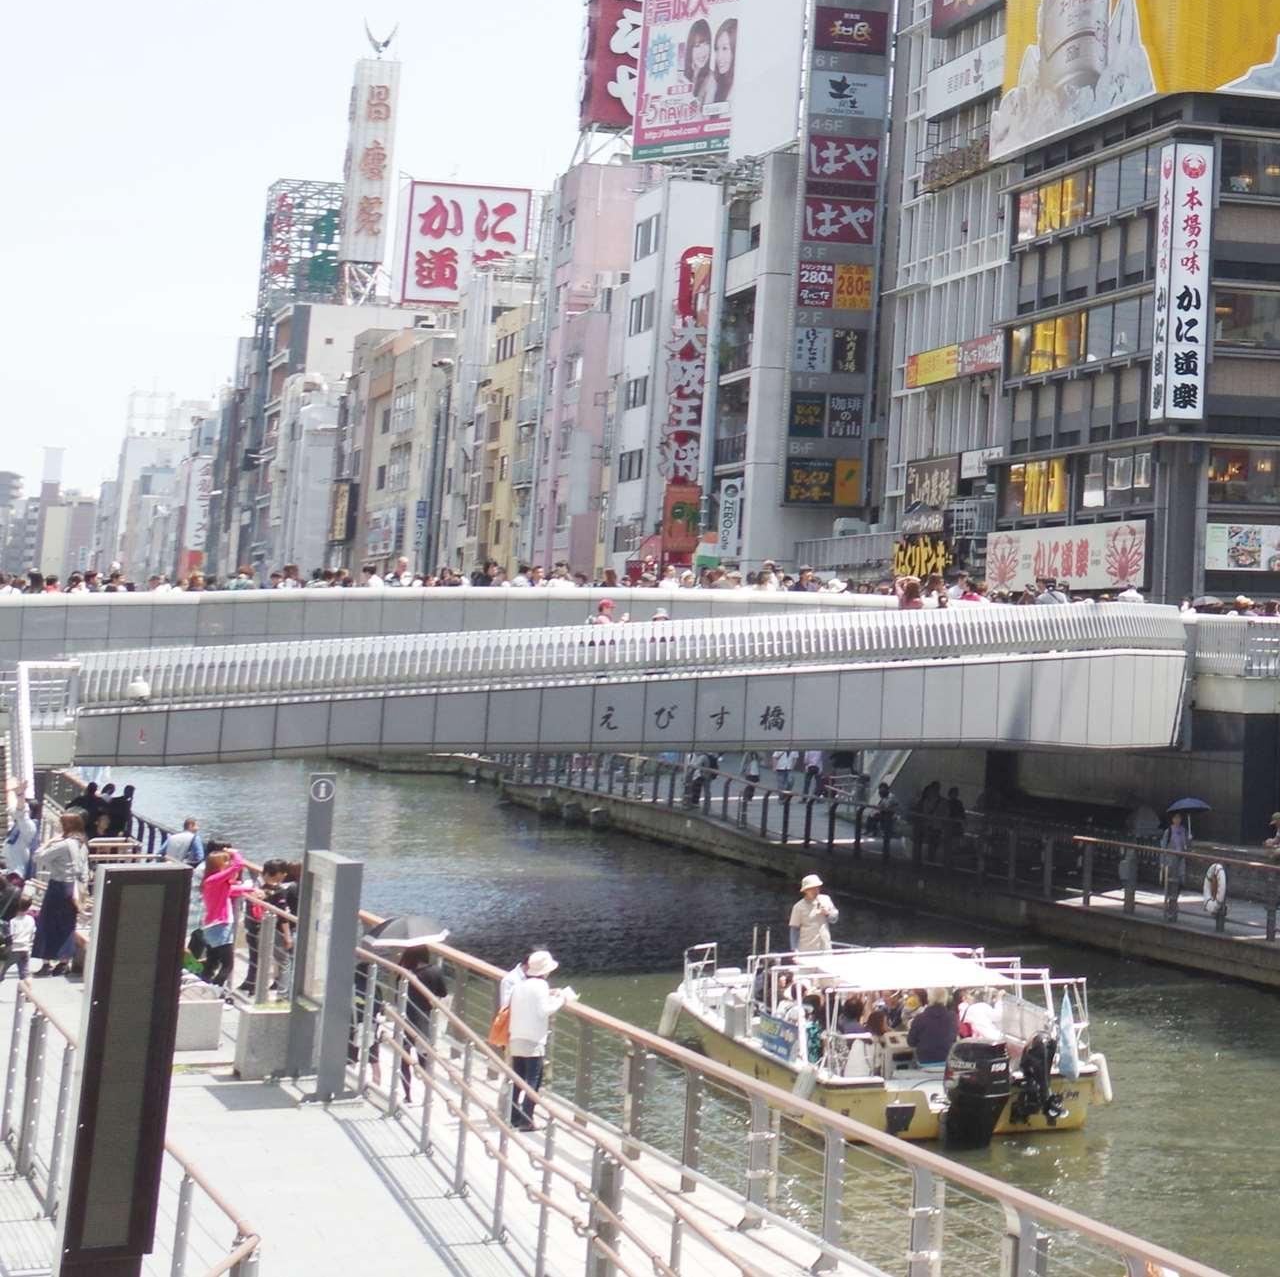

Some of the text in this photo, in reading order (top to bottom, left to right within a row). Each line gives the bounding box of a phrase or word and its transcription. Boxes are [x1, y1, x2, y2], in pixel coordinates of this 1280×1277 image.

[810, 140, 878, 177] はや
[418, 194, 518, 245] かに
[805, 202, 875, 239] はや
[1180, 186, 1202, 276] 本場の味
[414, 246, 511, 291] 道
[1172, 285, 1202, 409] かに道楽
[657, 314, 709, 482] 大阪王将
[840, 410, 852, 422] の
[599, 705, 786, 732] えびす橋
